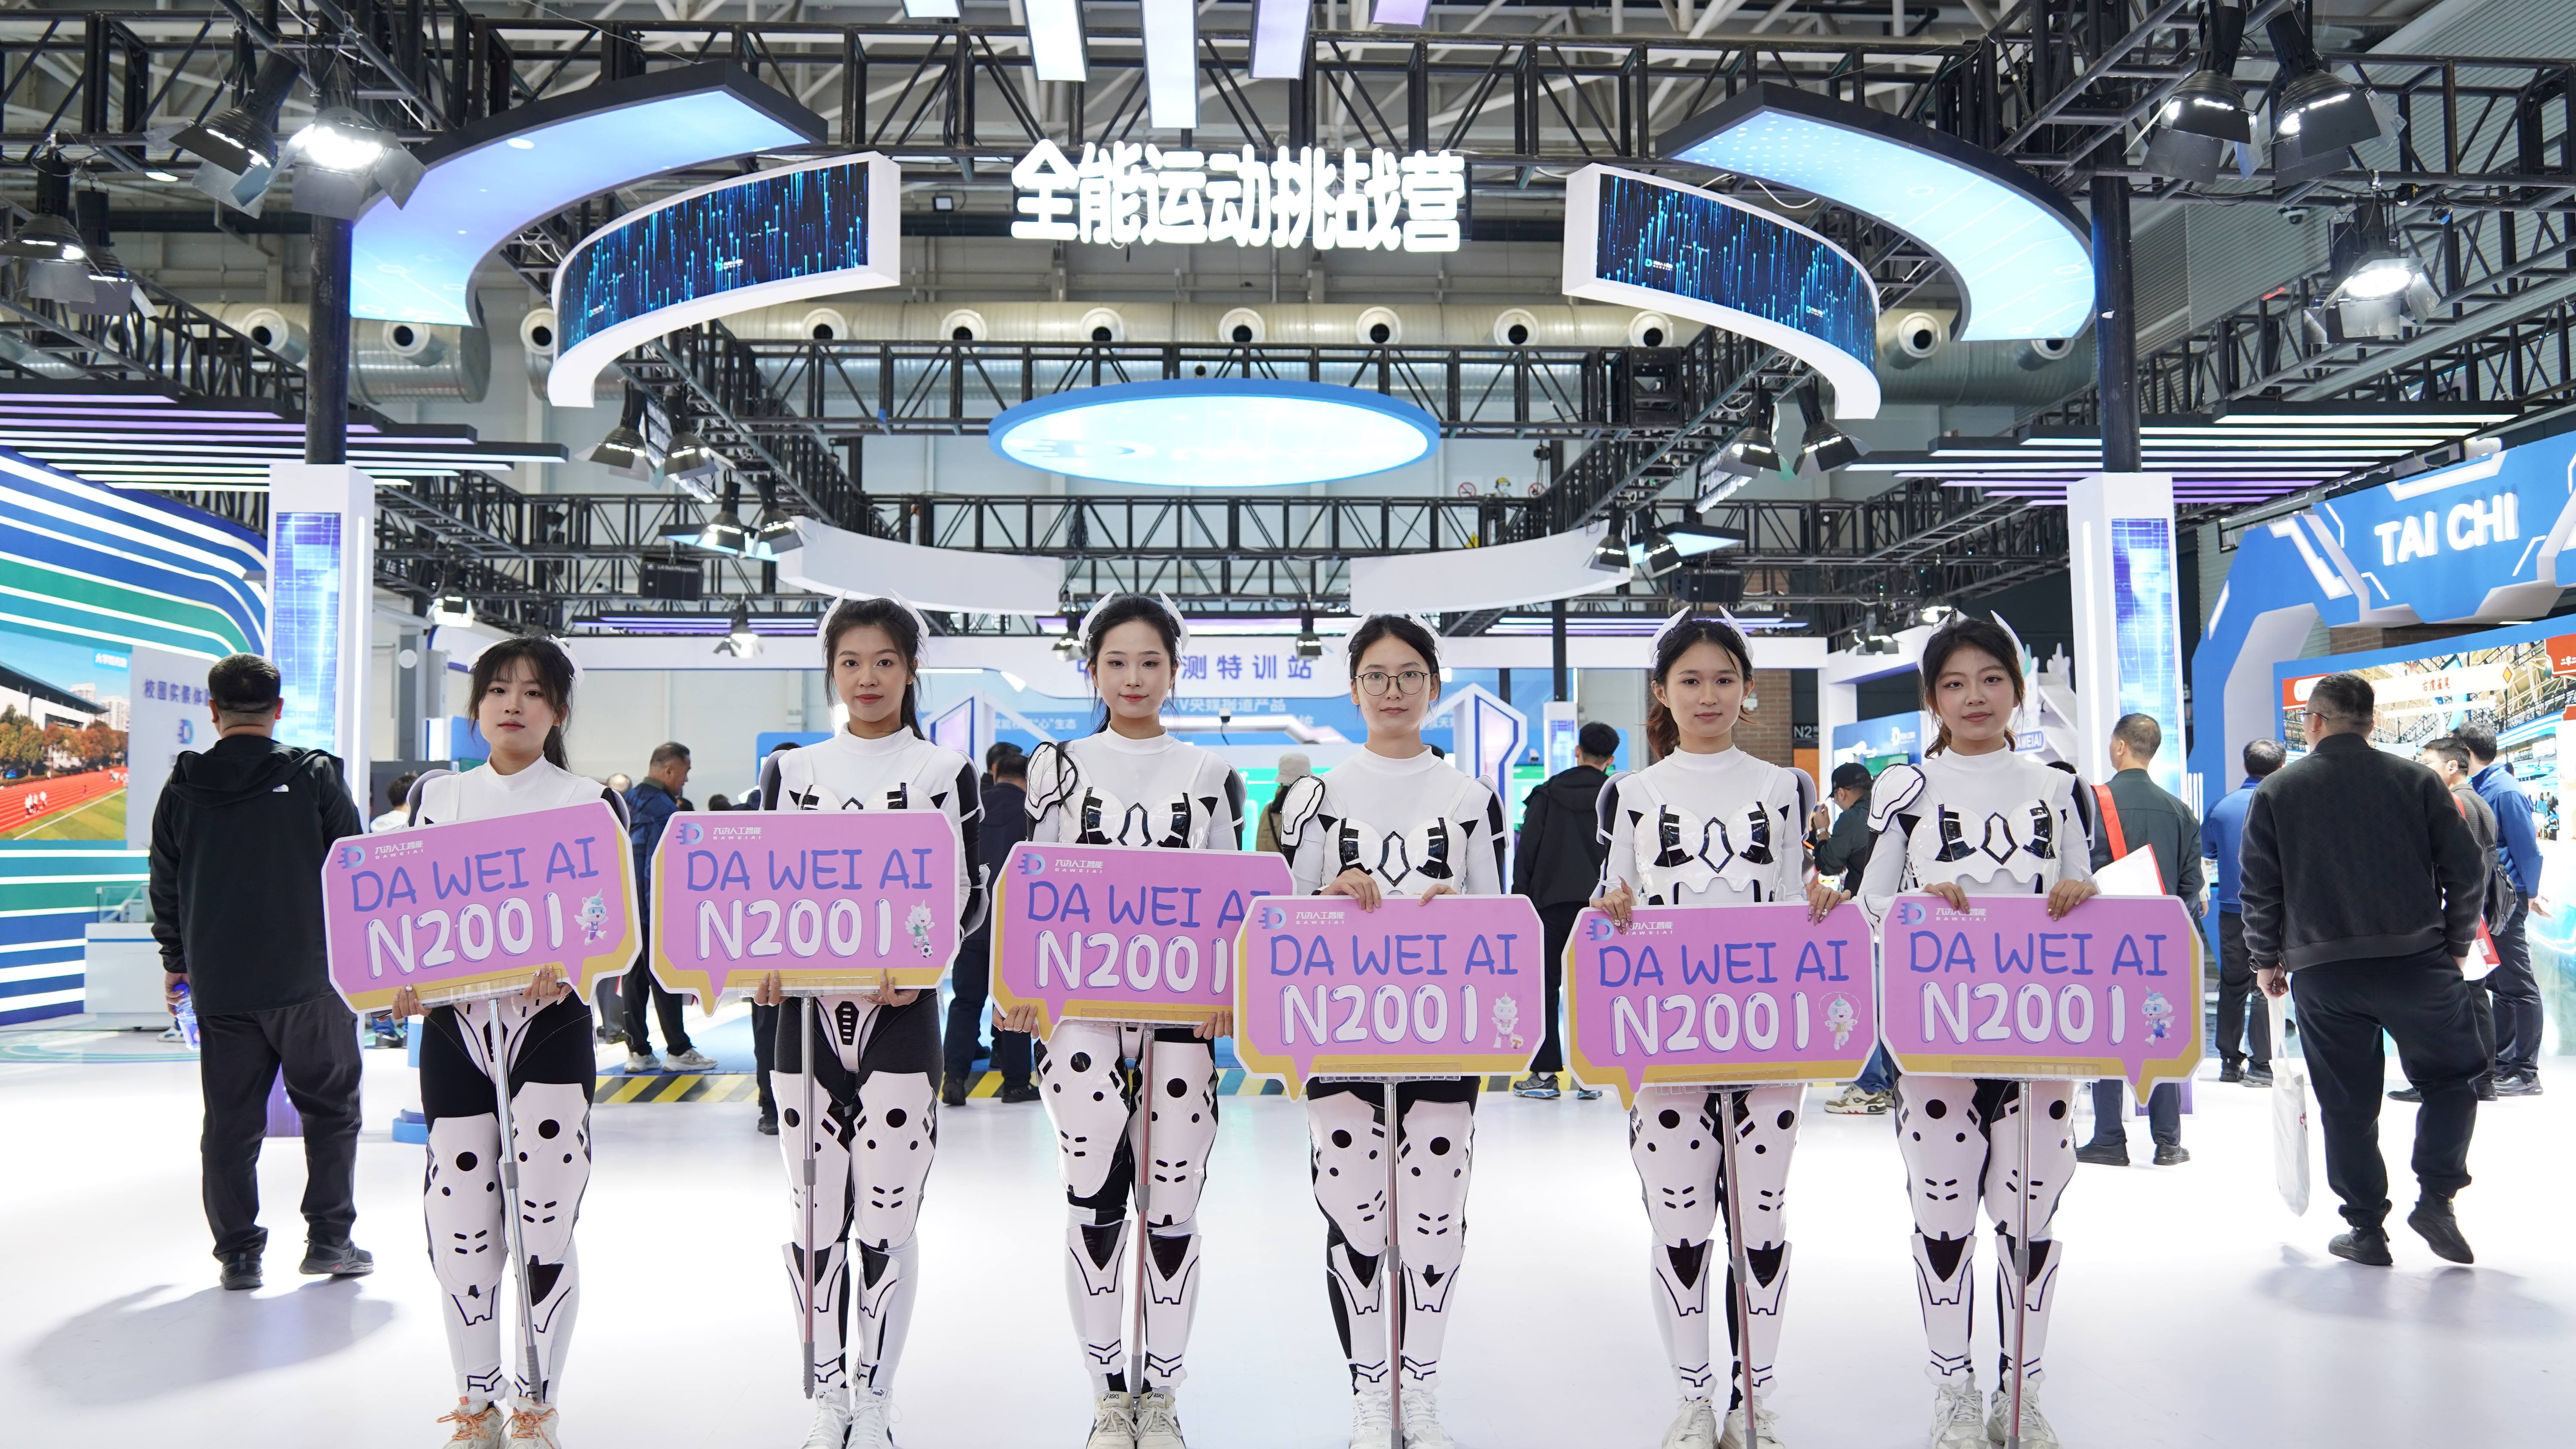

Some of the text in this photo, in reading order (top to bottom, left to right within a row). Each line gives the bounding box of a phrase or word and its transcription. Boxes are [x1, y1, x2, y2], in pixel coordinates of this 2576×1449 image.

[1011, 139, 1465, 252] 全能运动挑战营
[2374, 492, 2519, 566] TAI CHI
[352, 837, 599, 912] DA WEI AI
[375, 849, 423, 859] DAWEIAI
[687, 848, 933, 891] DA WEI AI
[365, 891, 563, 979] N2001
[696, 898, 892, 961] N2001
[1028, 881, 1270, 928] DA WEI A
[1035, 929, 1228, 995] N2001
[1270, 934, 1518, 976] DA WEI AI
[1599, 940, 1849, 987] DA WEI AI
[1910, 930, 2168, 976] DA WEI AI
[1280, 984, 1478, 1046] N2001
[1610, 991, 1810, 1057] N2001
[1920, 981, 2126, 1045] N2001
